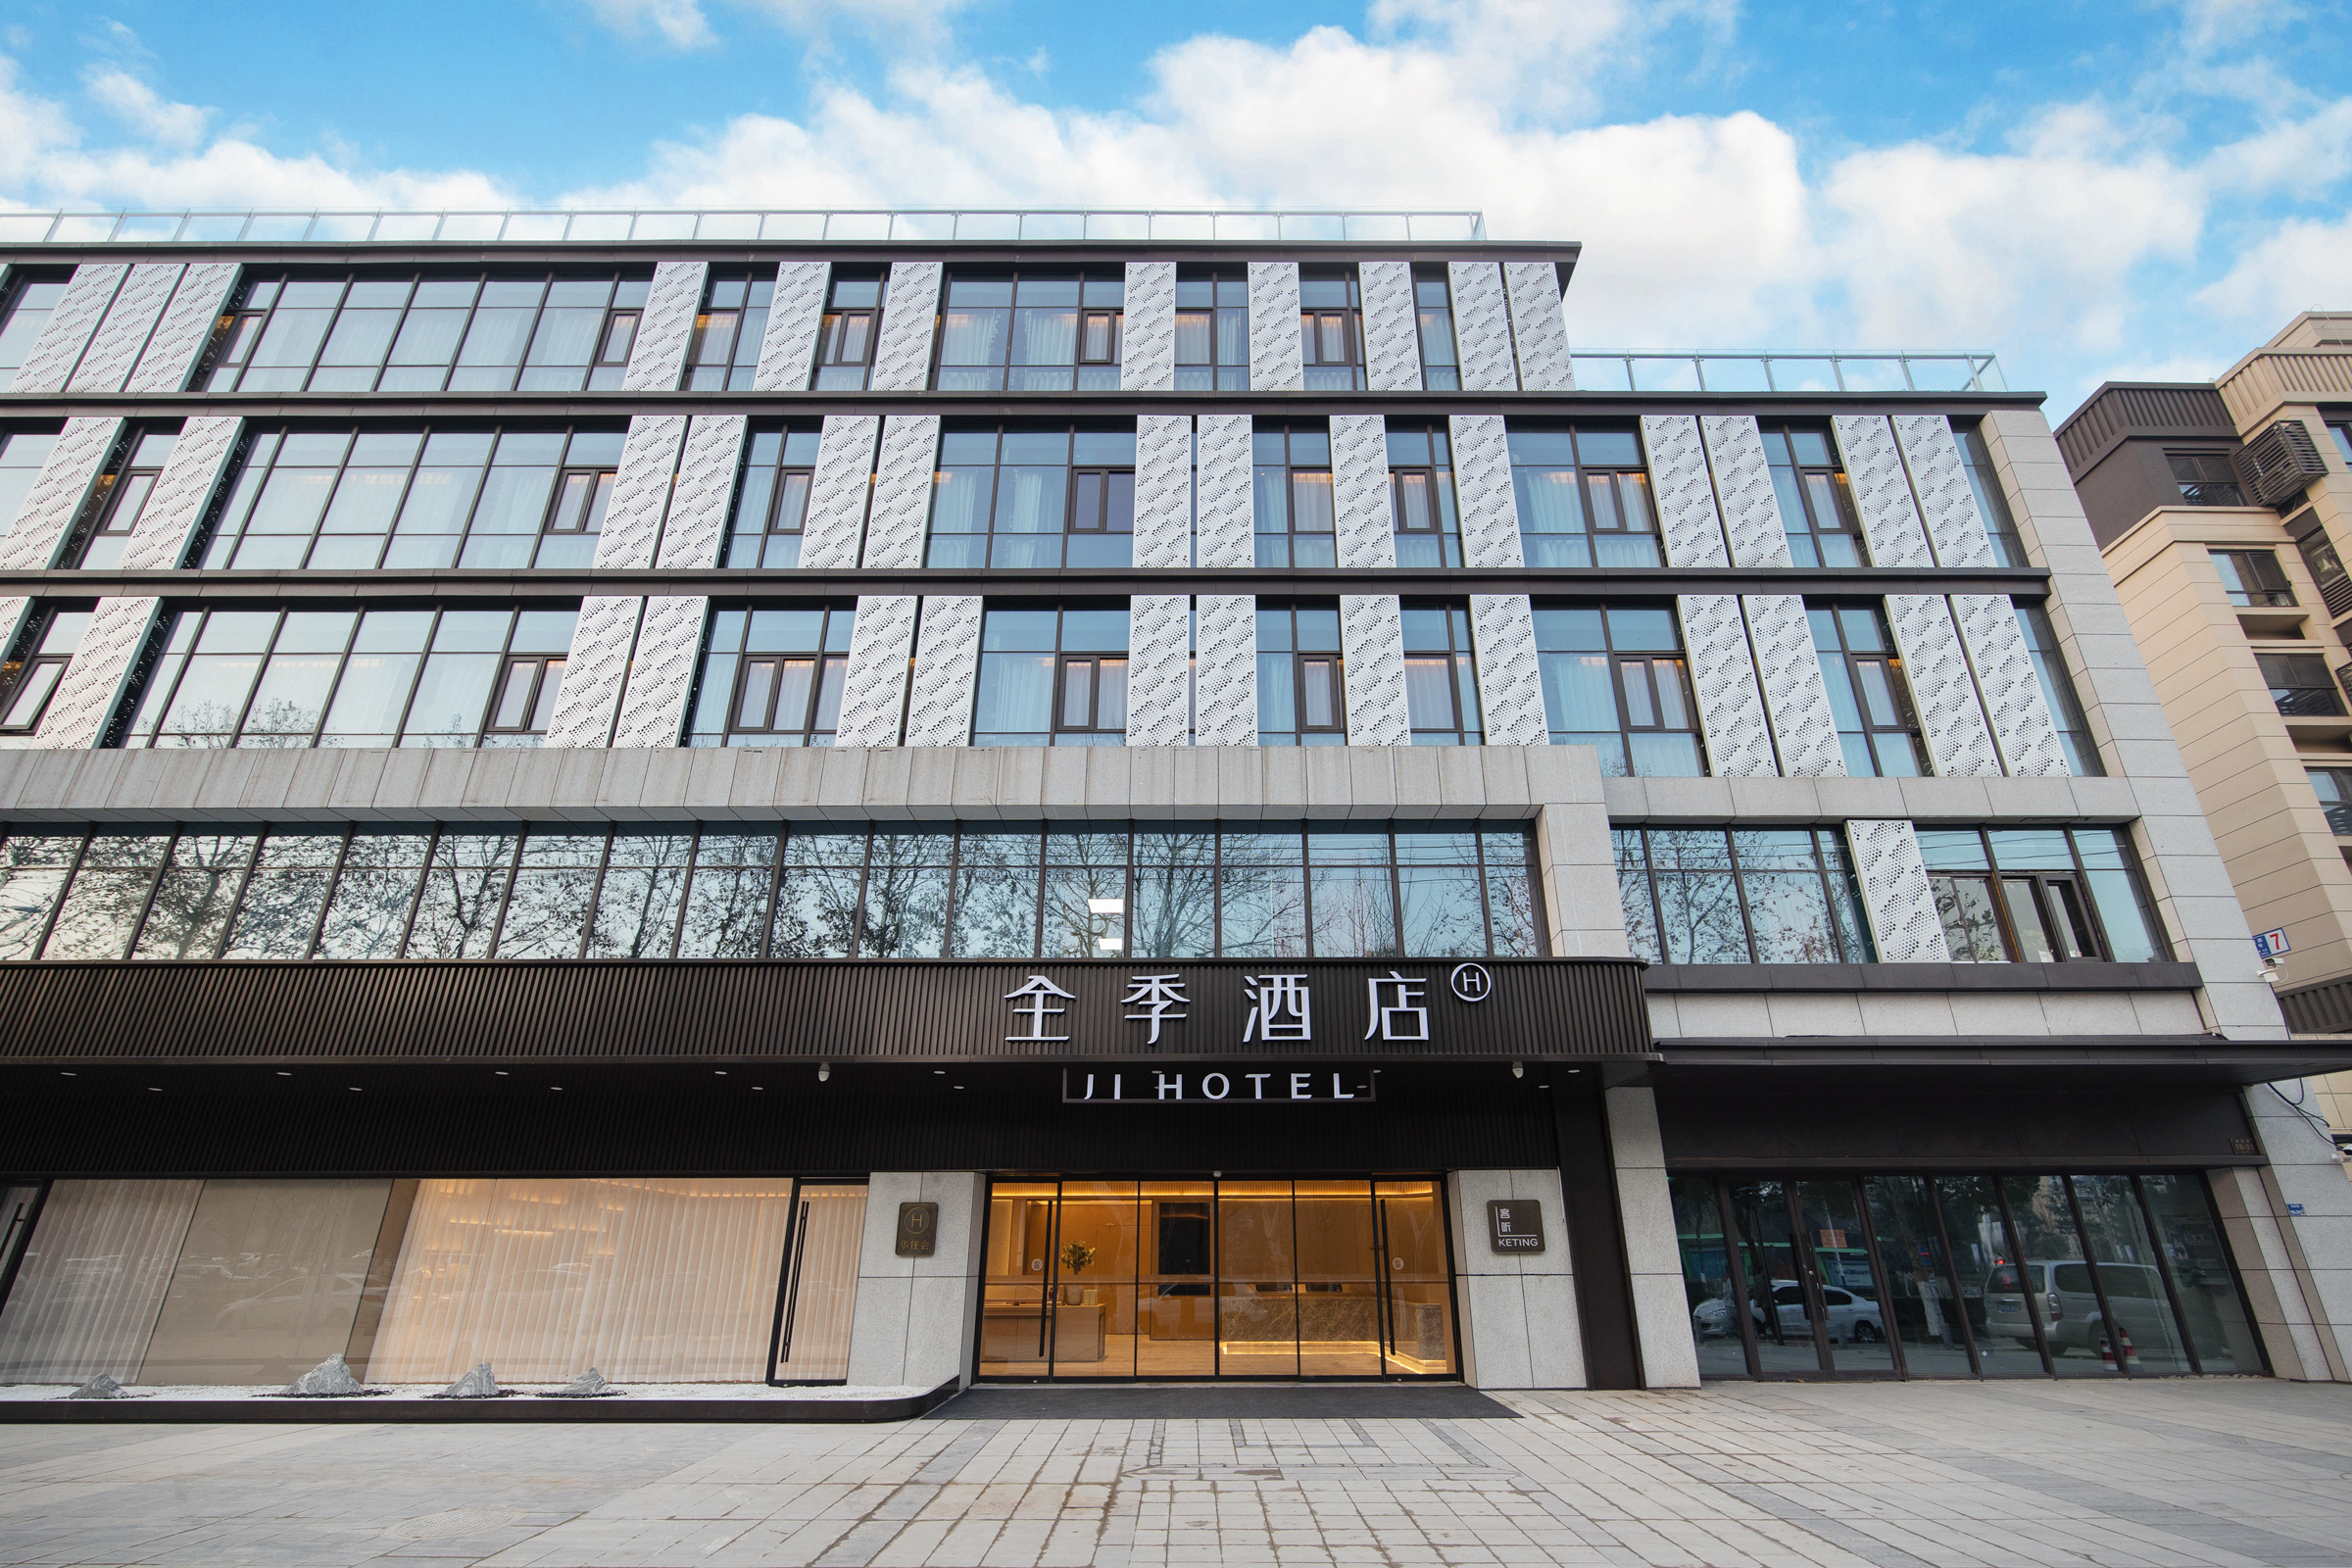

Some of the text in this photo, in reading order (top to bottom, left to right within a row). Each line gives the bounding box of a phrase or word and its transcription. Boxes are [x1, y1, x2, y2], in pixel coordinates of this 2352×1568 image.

[2269, 933, 2280, 951] 7
[1004, 970, 1430, 1045] 全季酒店
[1083, 1072, 1355, 1101] JI HOTEL
[900, 1240, 930, 1250] 华住会
[1498, 1238, 1539, 1247] KETING
